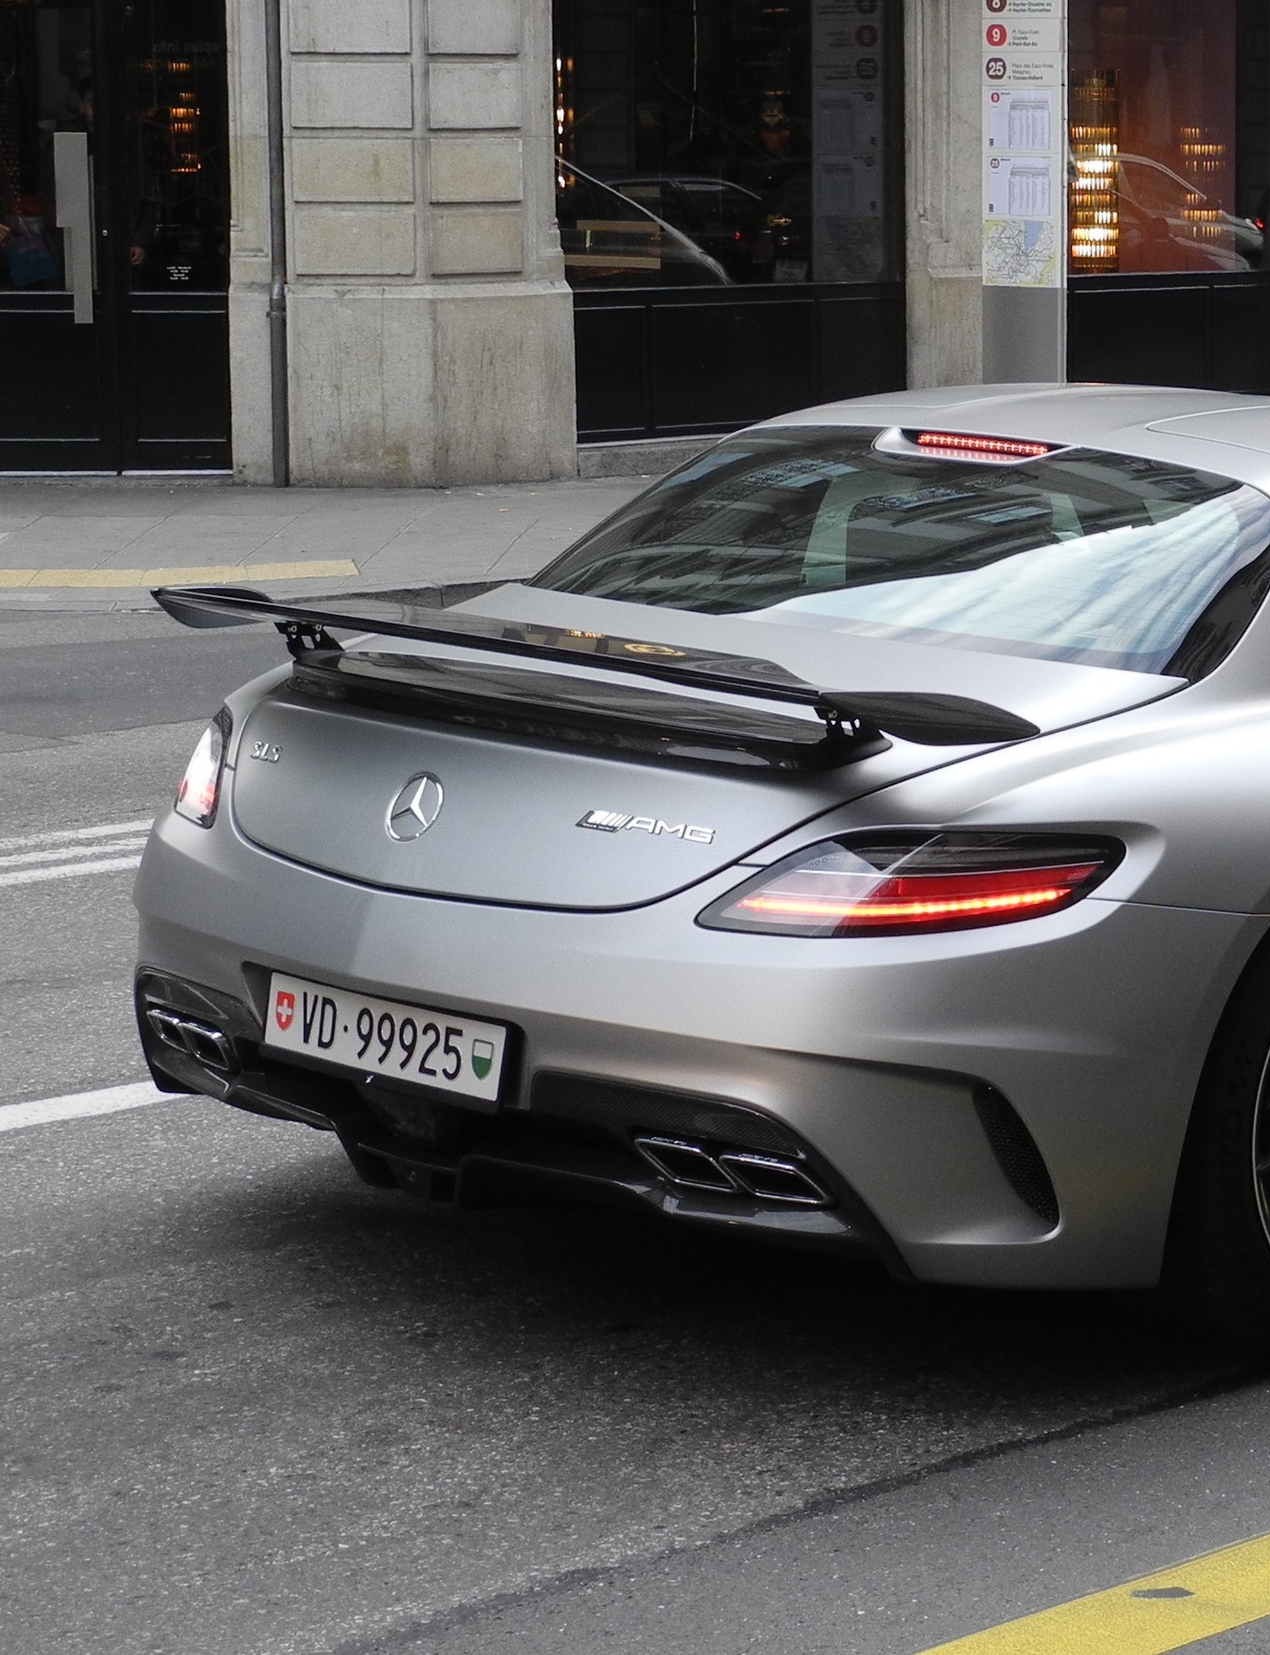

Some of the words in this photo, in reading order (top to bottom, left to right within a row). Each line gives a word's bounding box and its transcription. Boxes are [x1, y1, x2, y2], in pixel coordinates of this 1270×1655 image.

[992, 28, 1001, 42] 9
[988, 61, 1004, 76] 25
[250, 740, 283, 764] SLS
[625, 815, 716, 845] AMG
